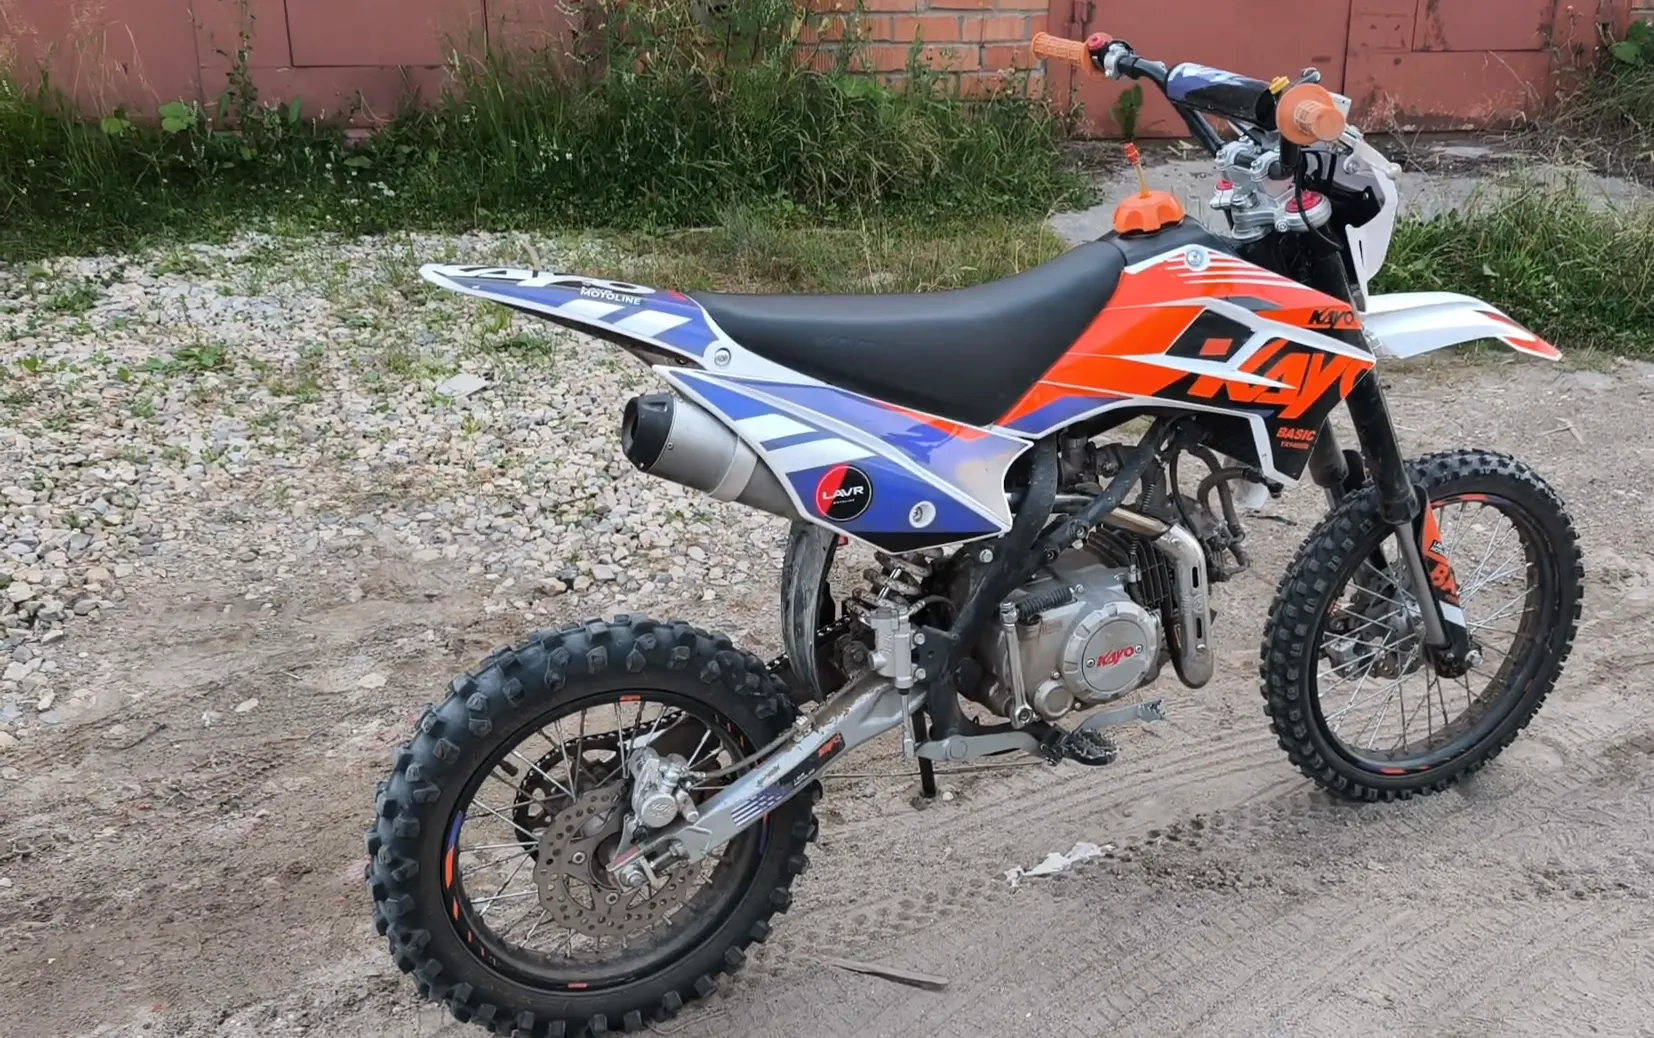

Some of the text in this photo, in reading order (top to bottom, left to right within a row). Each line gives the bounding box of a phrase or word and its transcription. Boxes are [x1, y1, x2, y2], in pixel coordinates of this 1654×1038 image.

[580, 288, 641, 305] MOTOLINE
[1308, 308, 1354, 328] KAYO
[1276, 427, 1316, 441] BASIC
[823, 486, 864, 499] LAVR
[1096, 646, 1134, 668] KAYO
